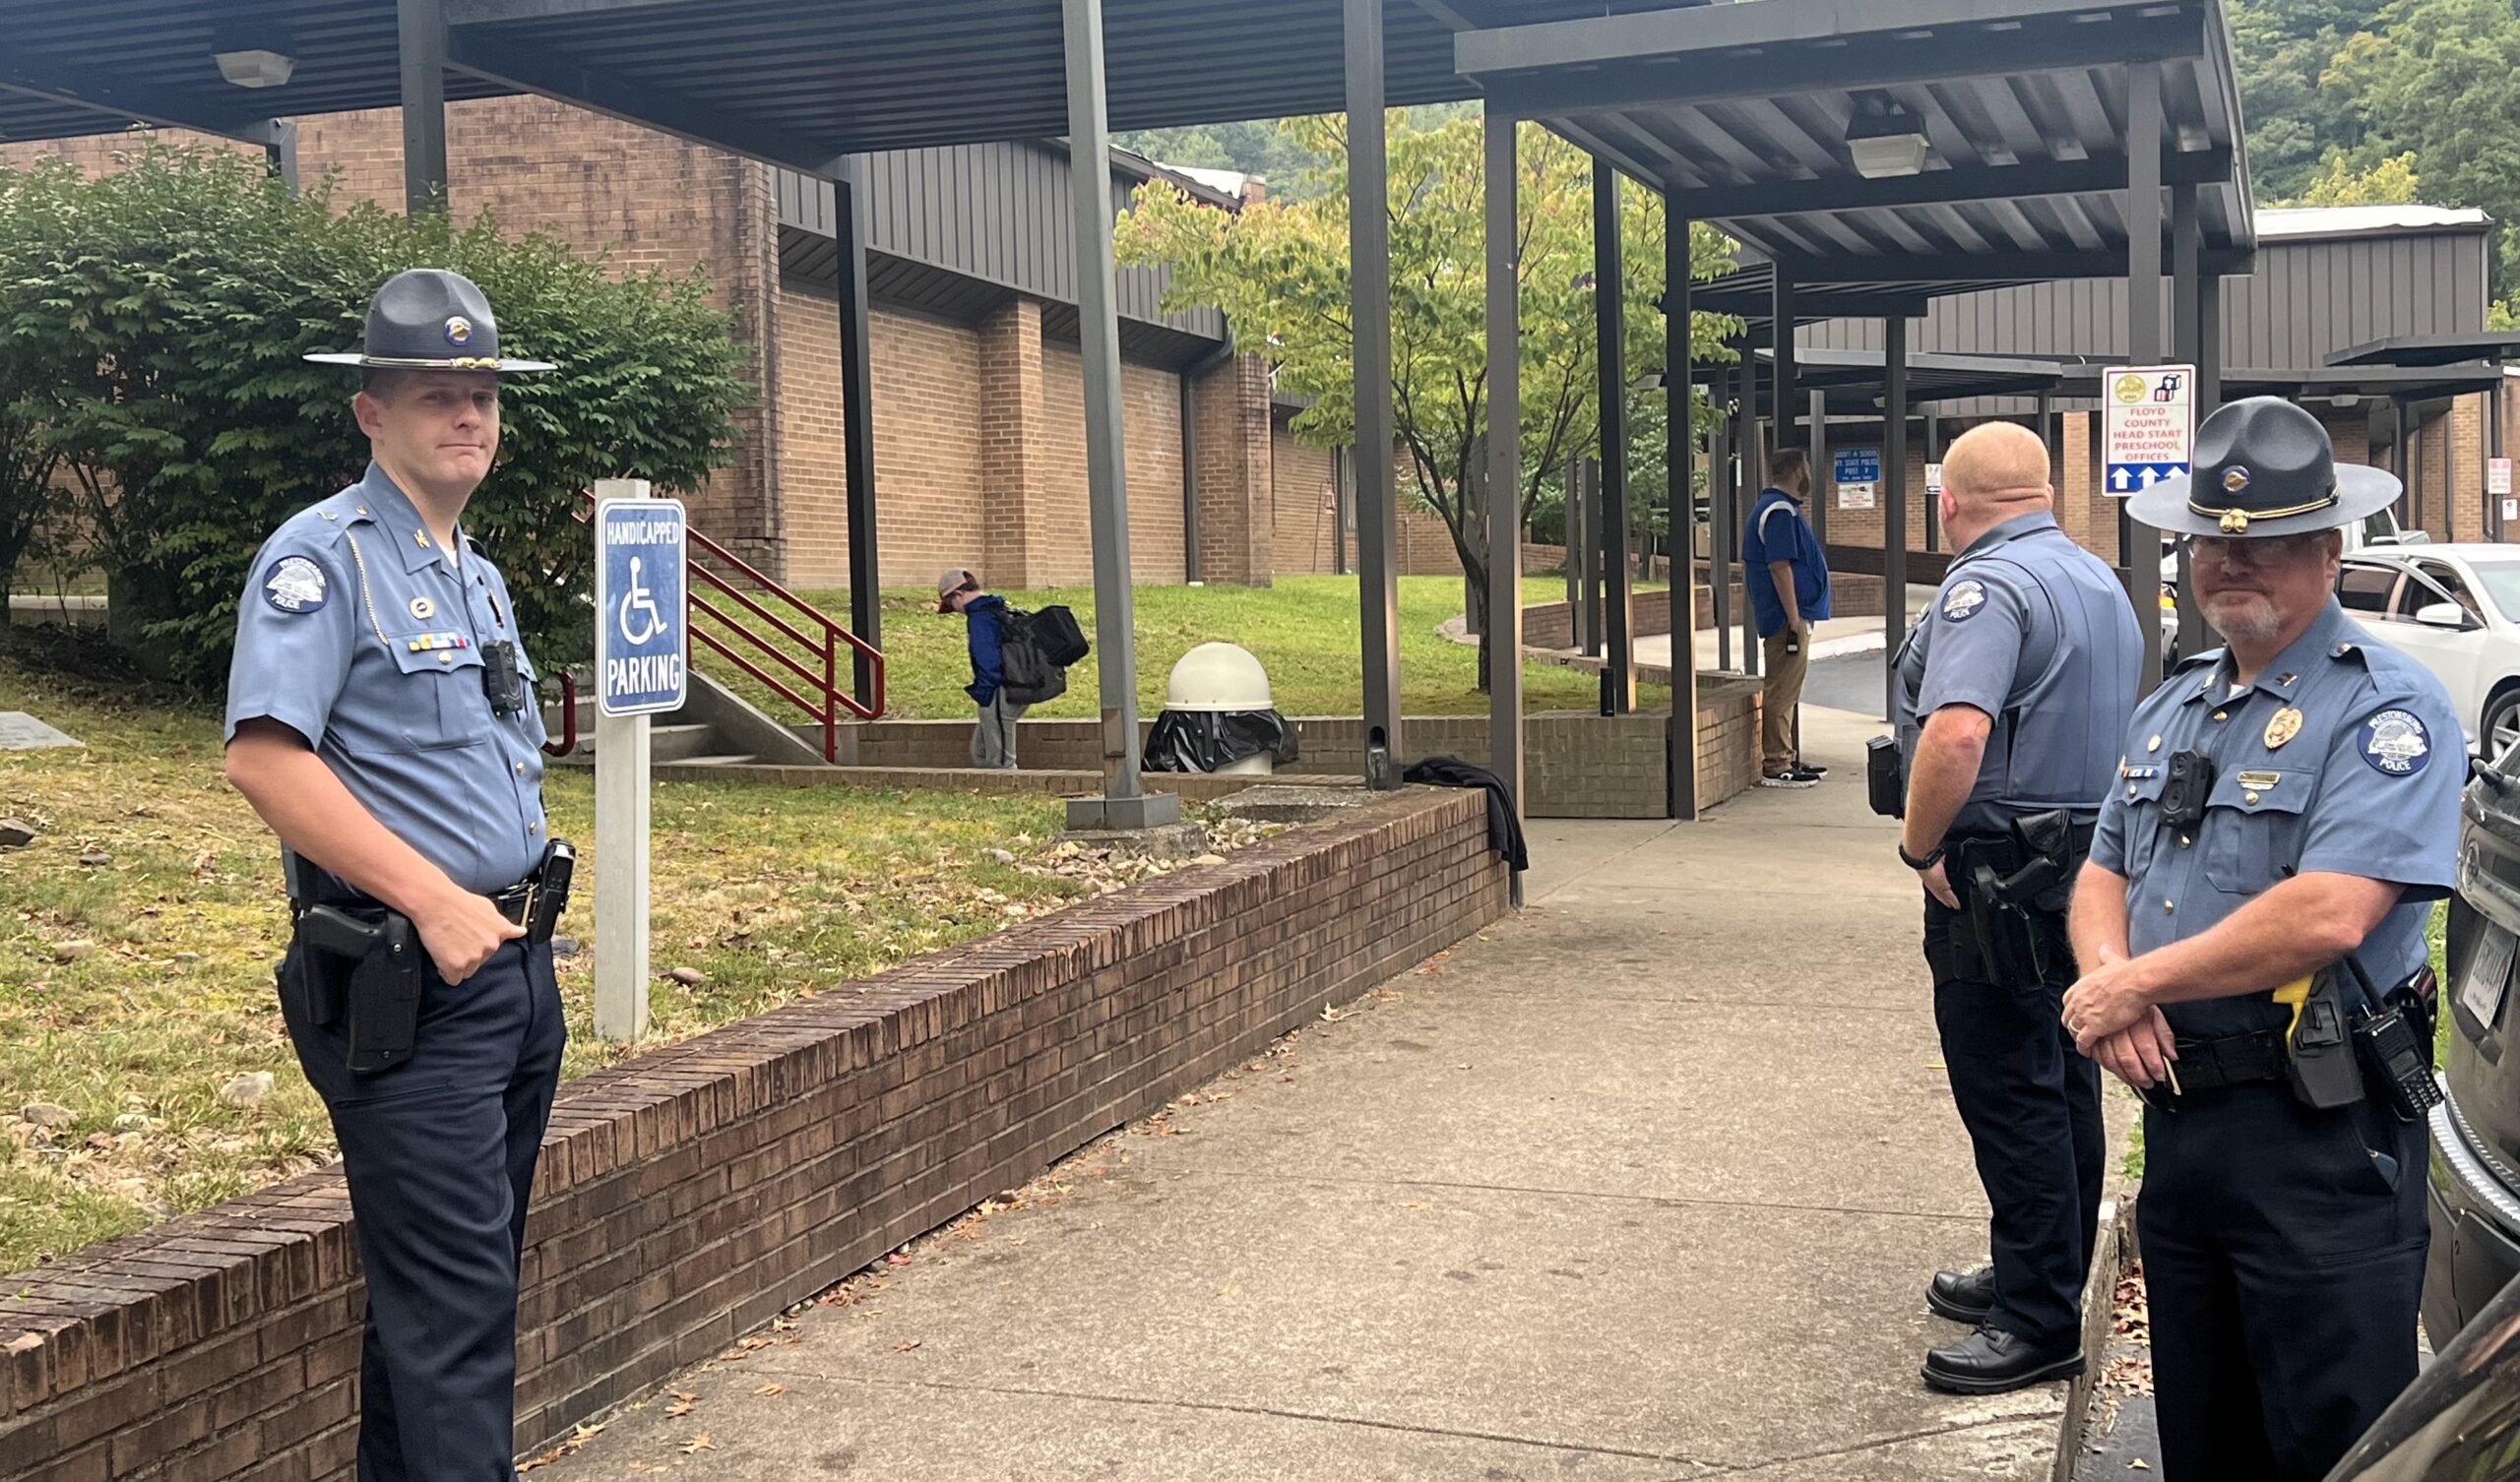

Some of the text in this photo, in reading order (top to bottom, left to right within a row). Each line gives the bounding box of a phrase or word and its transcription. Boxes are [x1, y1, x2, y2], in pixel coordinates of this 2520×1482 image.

[2130, 407, 2166, 416] FLOYD
[2124, 418, 2171, 428] COUNTY
[2114, 441, 2180, 451] PRESCHOOL
[2125, 453, 2170, 462] OFFICES
[606, 521, 679, 545] HANDICAPPED
[271, 593, 300, 610] POLICE
[607, 653, 680, 696] PARKING
[2379, 757, 2412, 772] POLICE
